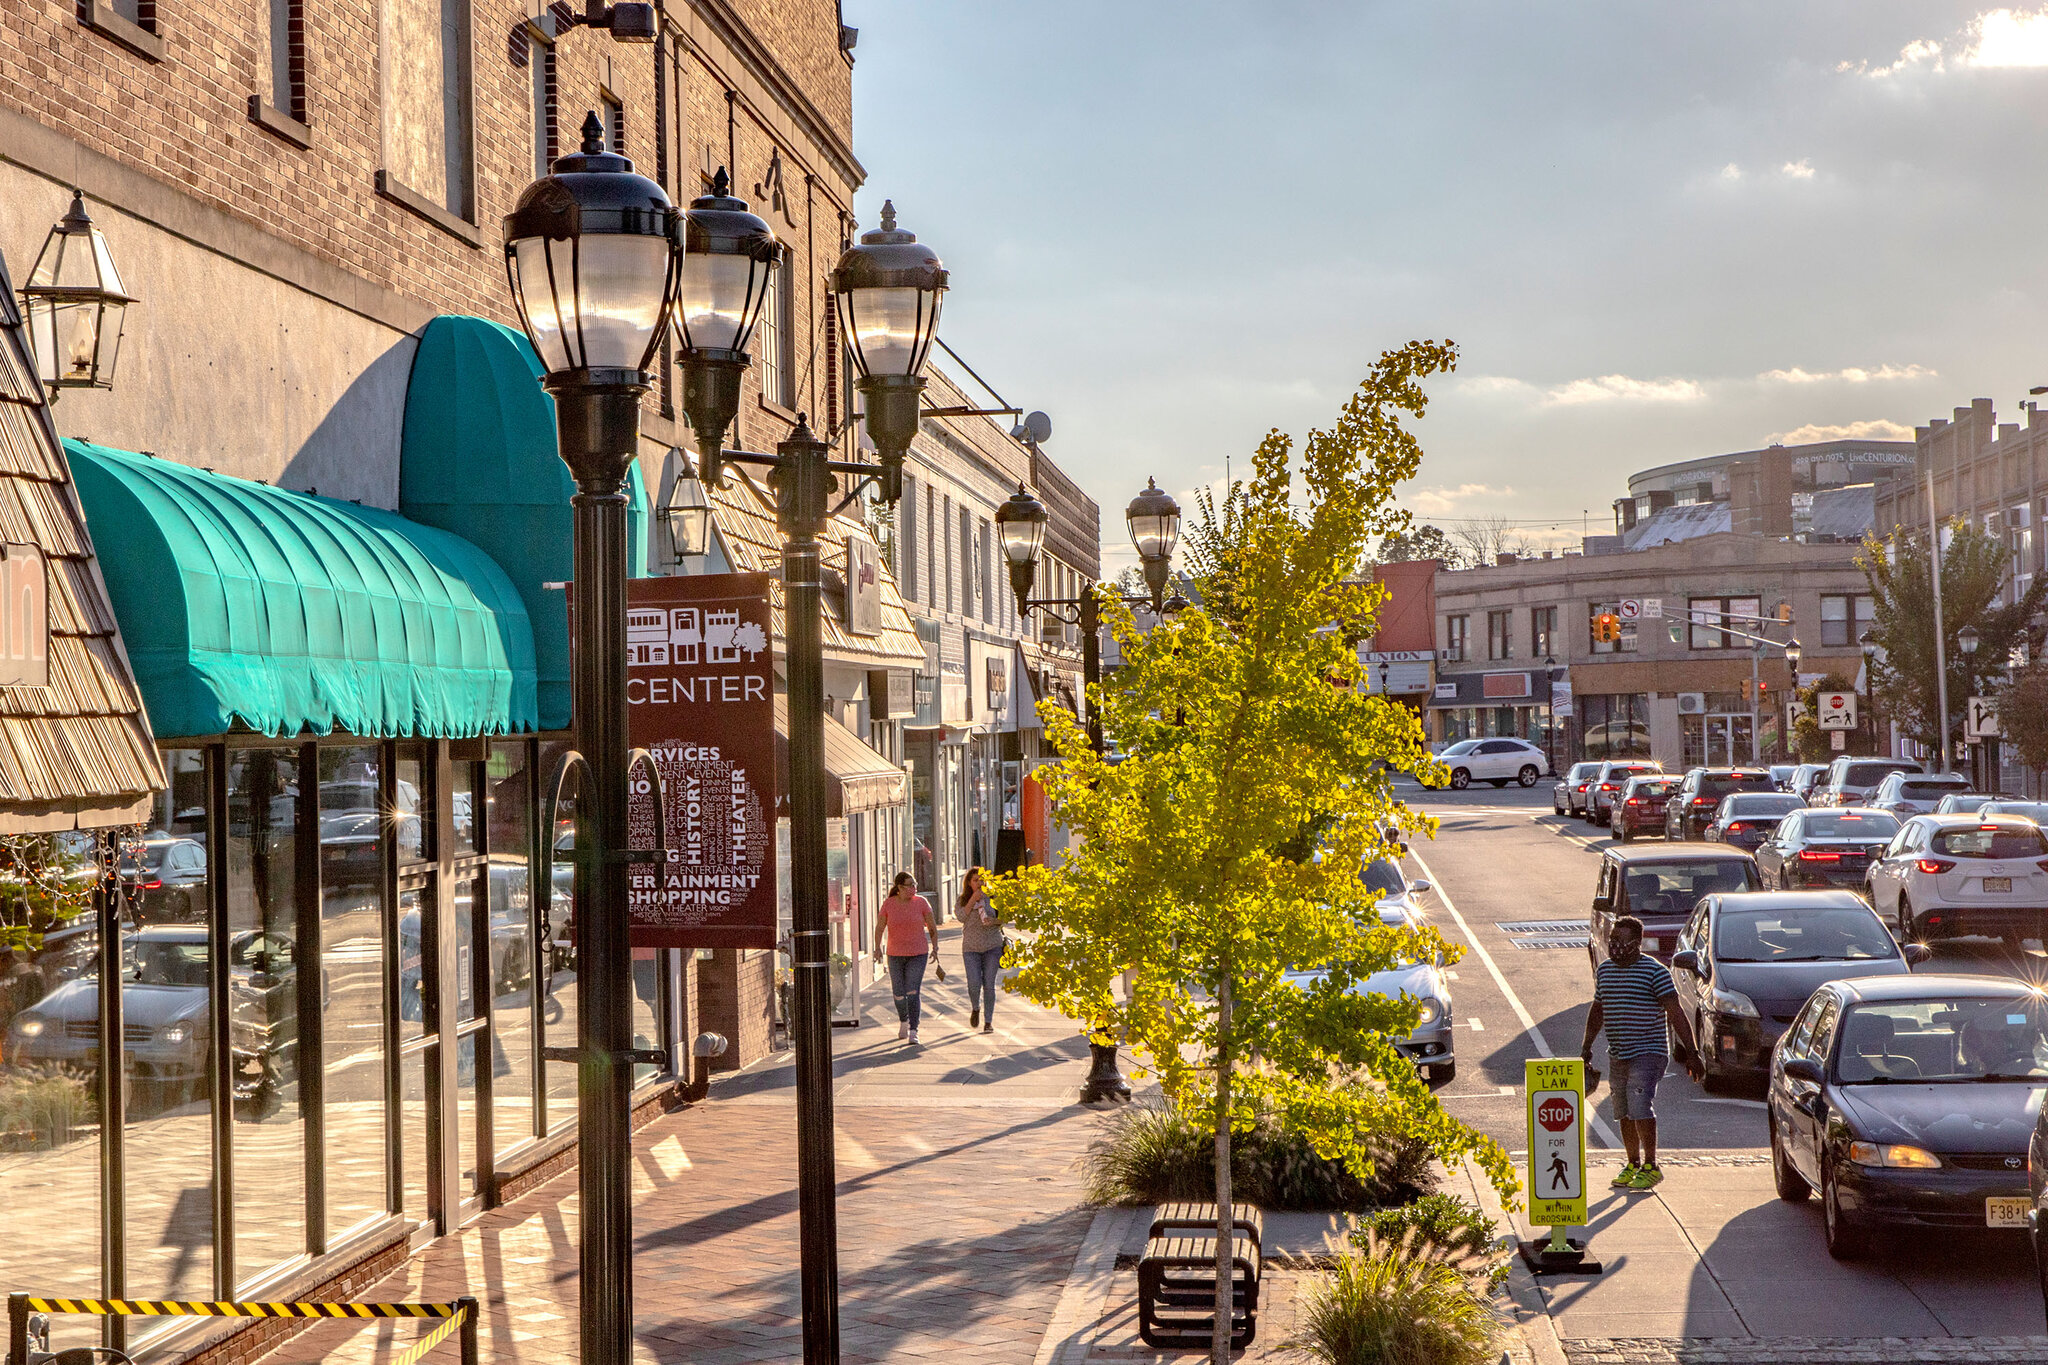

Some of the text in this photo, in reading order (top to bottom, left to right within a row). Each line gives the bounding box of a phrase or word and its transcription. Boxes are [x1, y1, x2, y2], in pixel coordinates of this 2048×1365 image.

[1365, 652, 1421, 661] UNION
[627, 675, 766, 705] CENTER
[628, 747, 720, 761] RVICES
[694, 769, 731, 778] EVENTS
[676, 779, 687, 828] SERVICES
[687, 775, 701, 865] HISTORY
[731, 769, 746, 865] THEATER
[680, 865, 761, 875] ENTERTAINMENT
[629, 890, 730, 904] SHOPPING
[666, 904, 708, 912] THEATER
[1536, 1065, 1574, 1076] STATE
[1542, 1078, 1569, 1089] LAW
[1539, 1108, 1573, 1122] STOP
[1548, 1139, 1565, 1147] FOR
[1545, 1204, 1573, 1213] WITHIN
[1535, 1214, 1582, 1224] CROSSWALK
